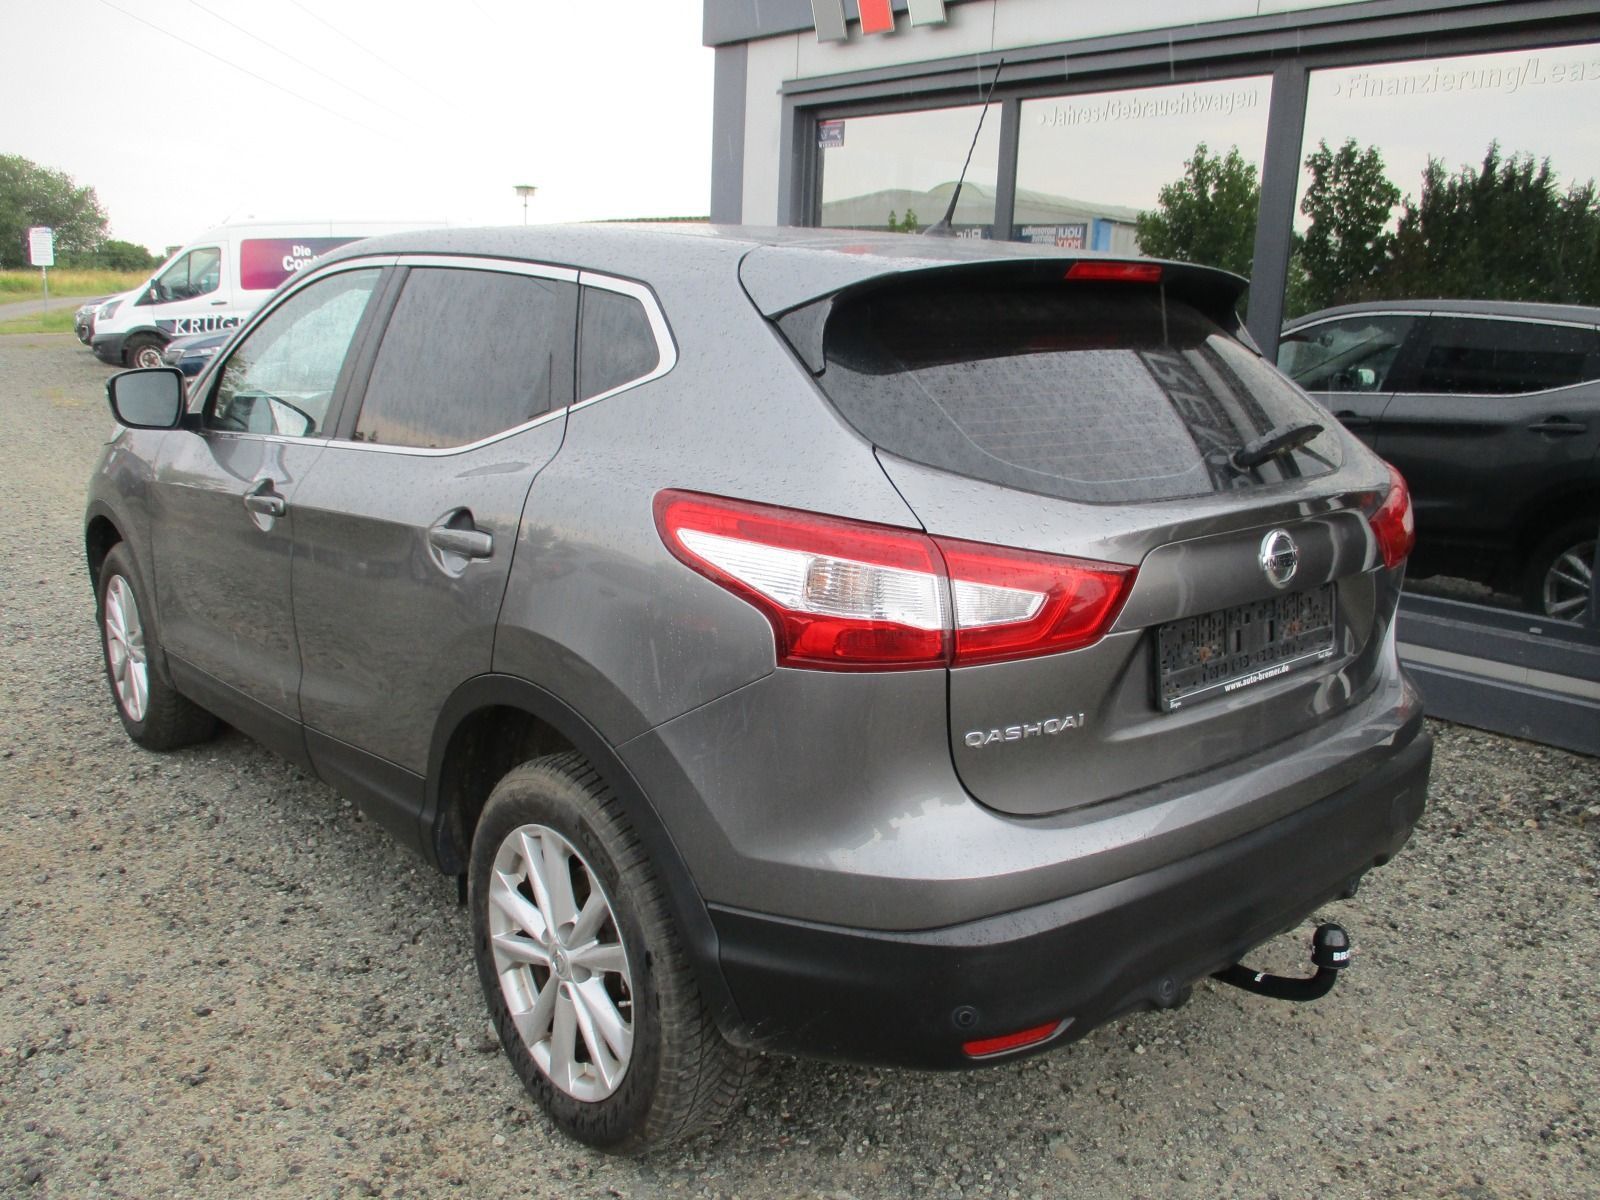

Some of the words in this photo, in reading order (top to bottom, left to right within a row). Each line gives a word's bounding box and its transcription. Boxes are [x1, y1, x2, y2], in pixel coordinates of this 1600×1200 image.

[292, 245, 312, 257] Die
[1224, 665, 1289, 692] www.auto-bremer.de
[964, 713, 1085, 749] QASHQAI
